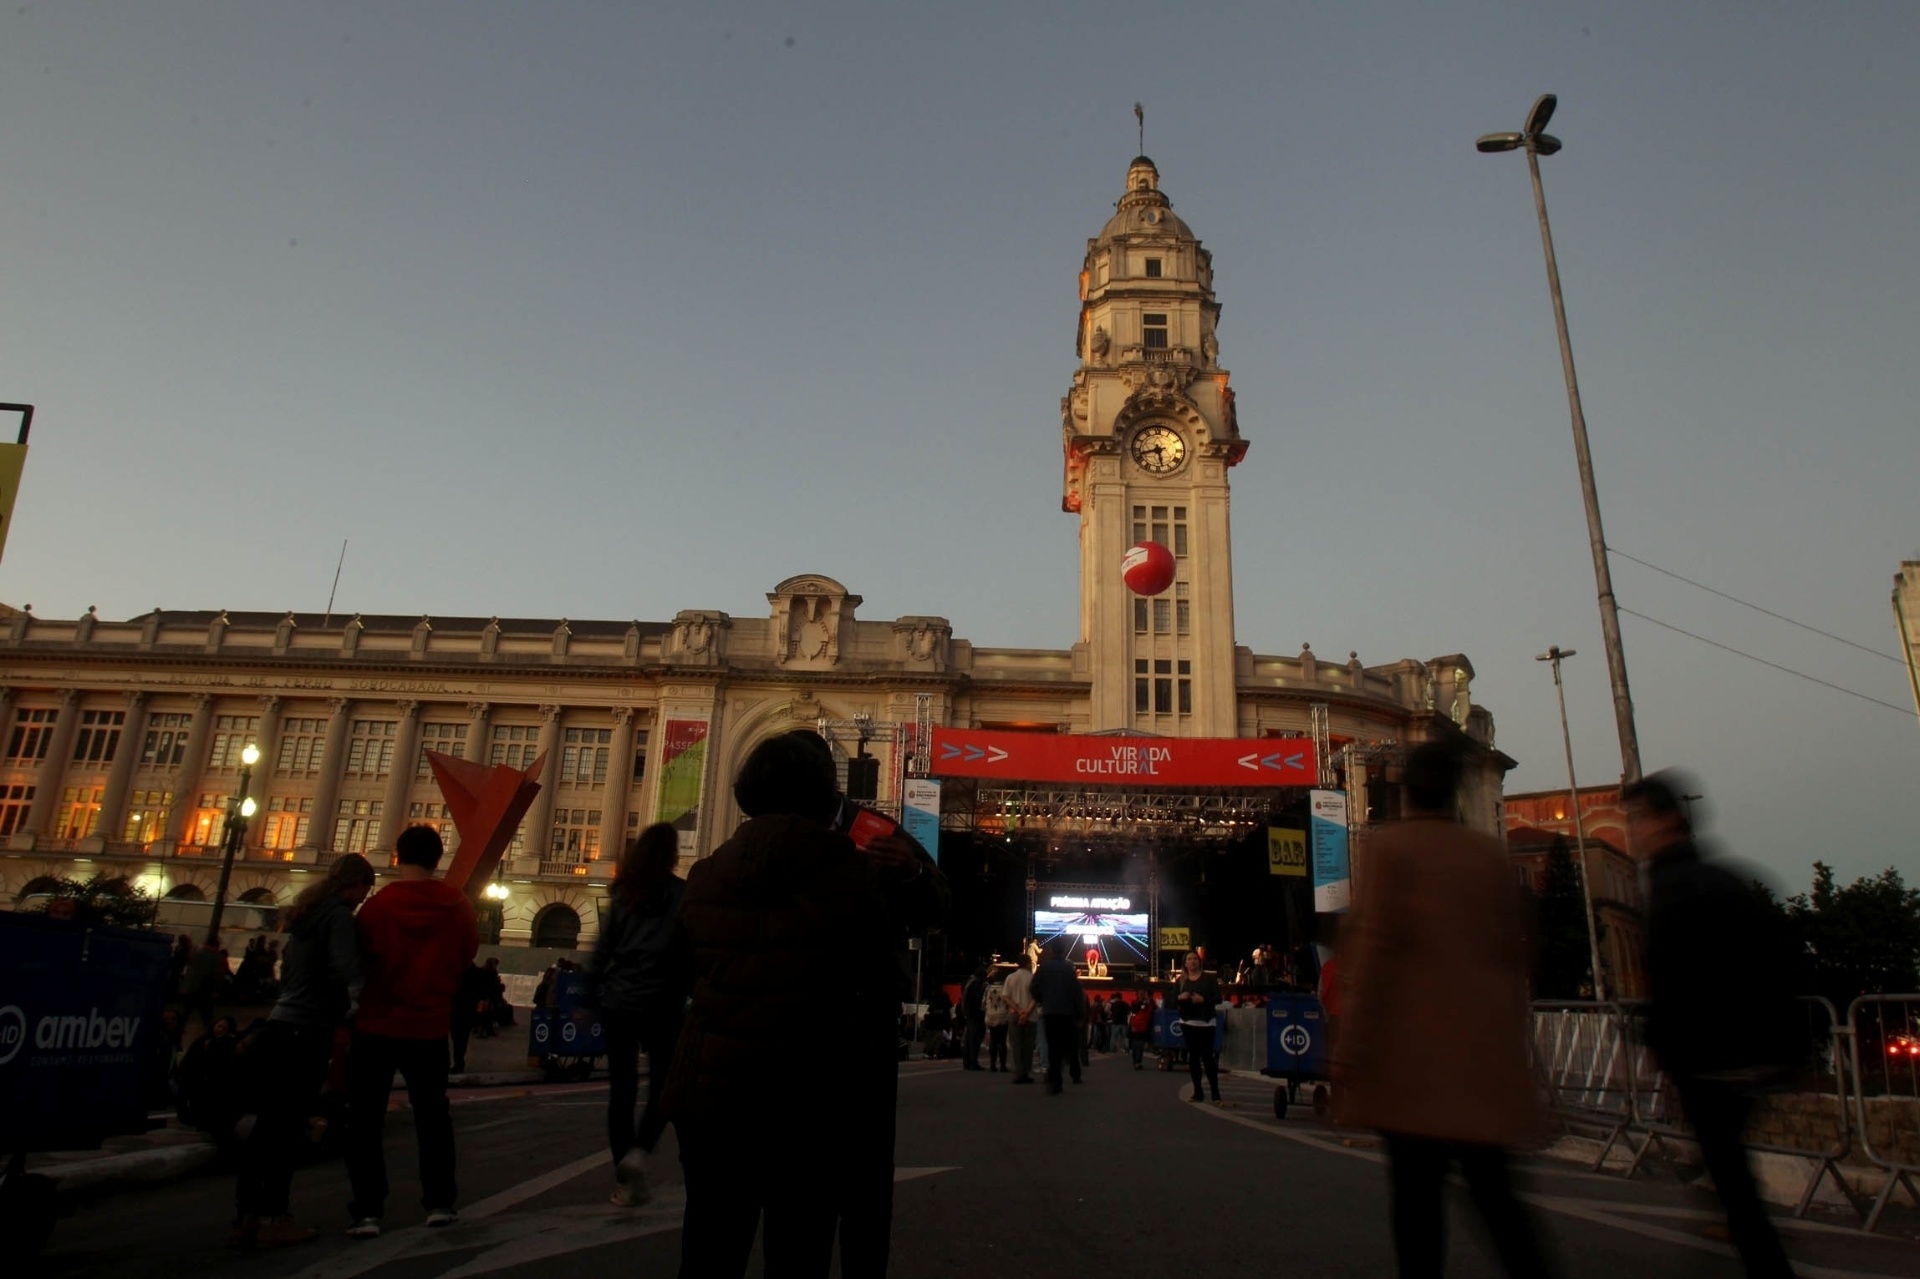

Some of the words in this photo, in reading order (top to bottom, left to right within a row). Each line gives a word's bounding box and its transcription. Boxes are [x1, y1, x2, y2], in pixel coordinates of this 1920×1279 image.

[1111, 746, 1171, 761] VIRADA
[1076, 758, 1159, 774] CULTURAL
[1270, 838, 1305, 867] BAR
[1160, 933, 1190, 946] BAR
[35, 1006, 140, 1050] ambev
